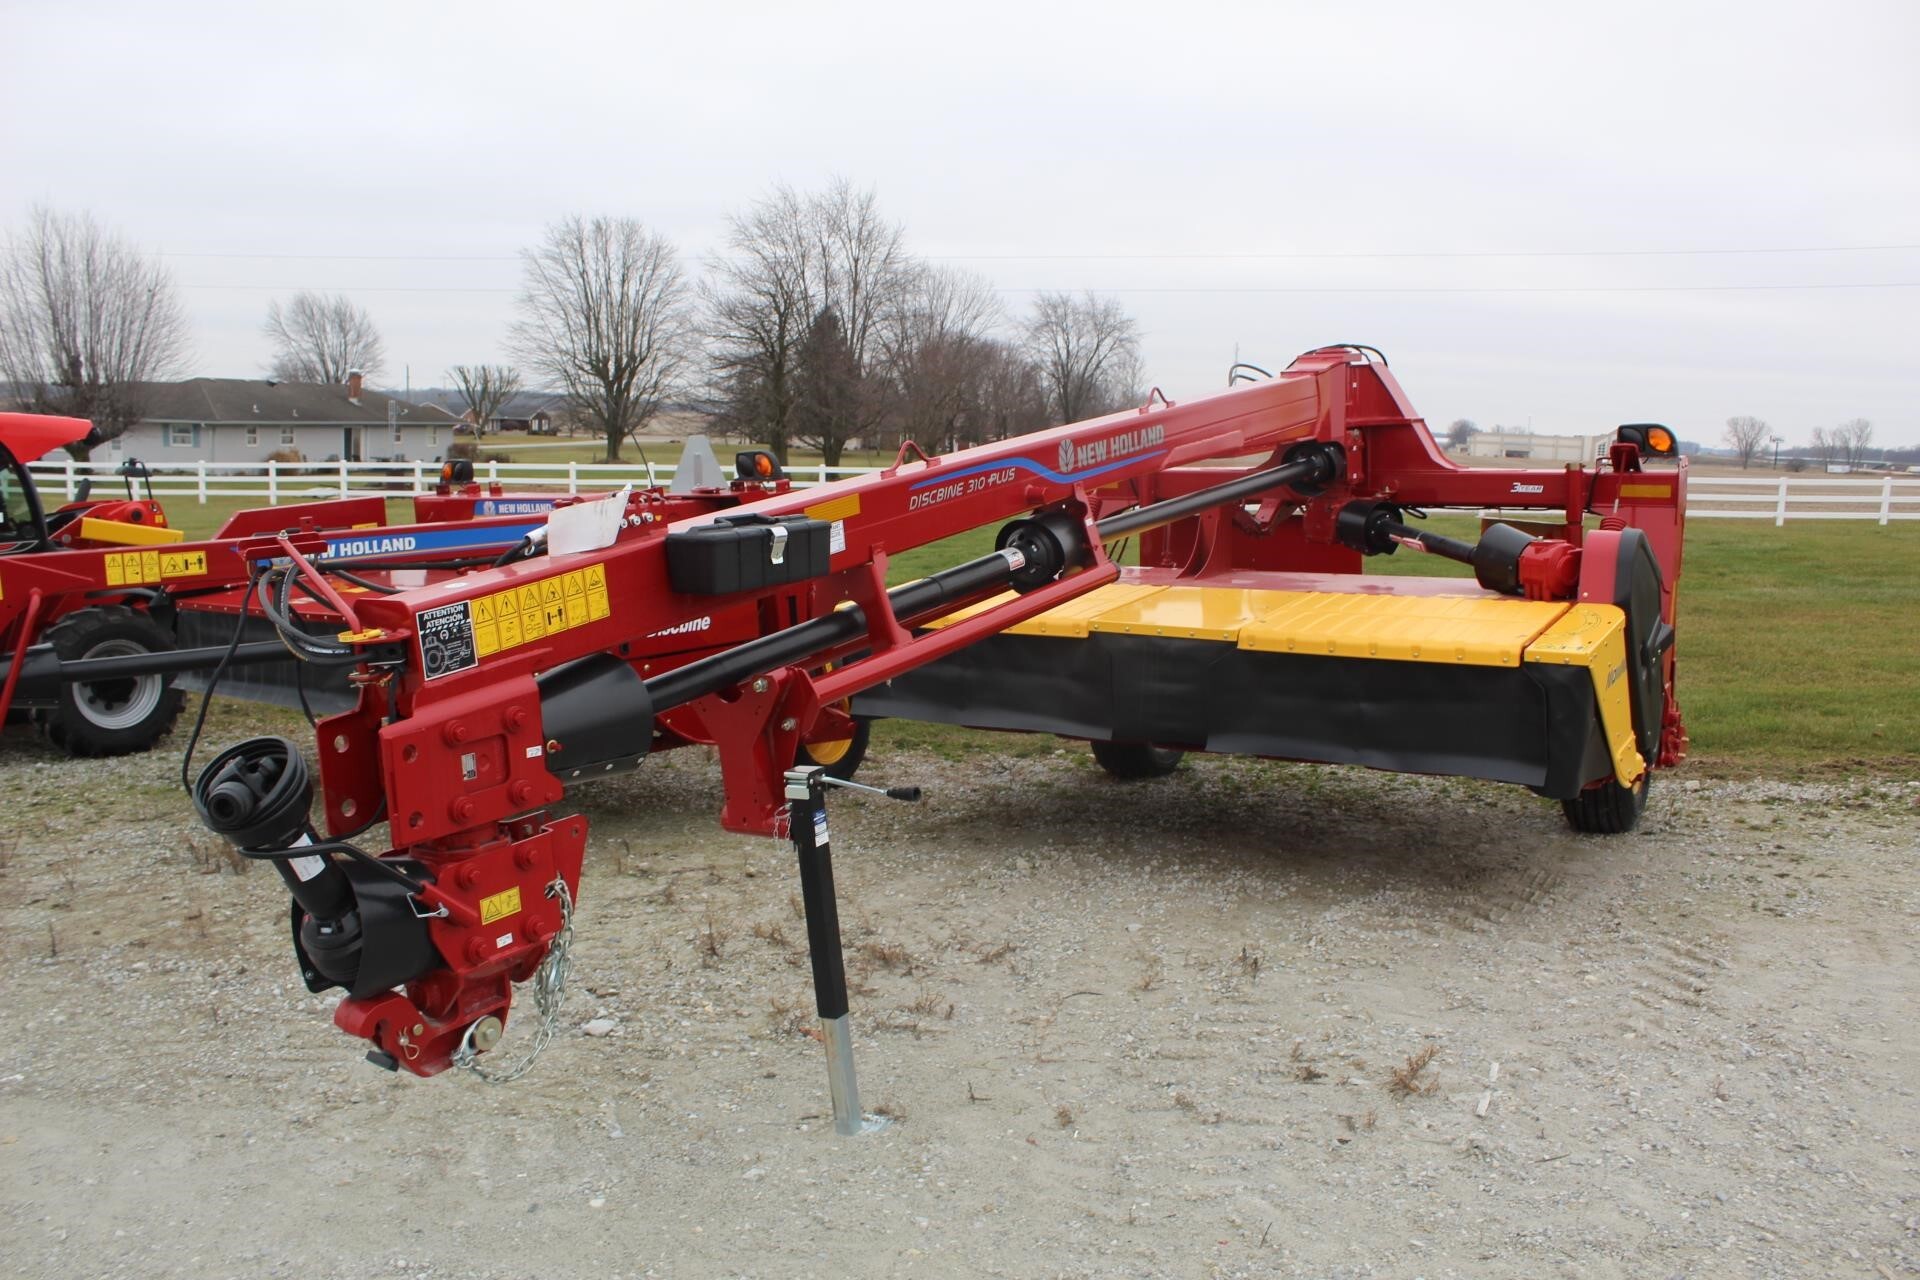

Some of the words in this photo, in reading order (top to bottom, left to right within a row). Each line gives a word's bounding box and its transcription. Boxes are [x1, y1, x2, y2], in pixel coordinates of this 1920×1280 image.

[1077, 439, 1107, 468] NEW
[1110, 424, 1164, 458] HOLLAND
[909, 482, 964, 511] DISCBINE
[967, 476, 986, 493] 310
[498, 504, 516, 514] NEW
[517, 503, 552, 513] HOLLAND
[340, 537, 416, 557] HOLLAND
[423, 604, 465, 620] ATTENTION
[426, 612, 464, 629] ATENCIÓN
